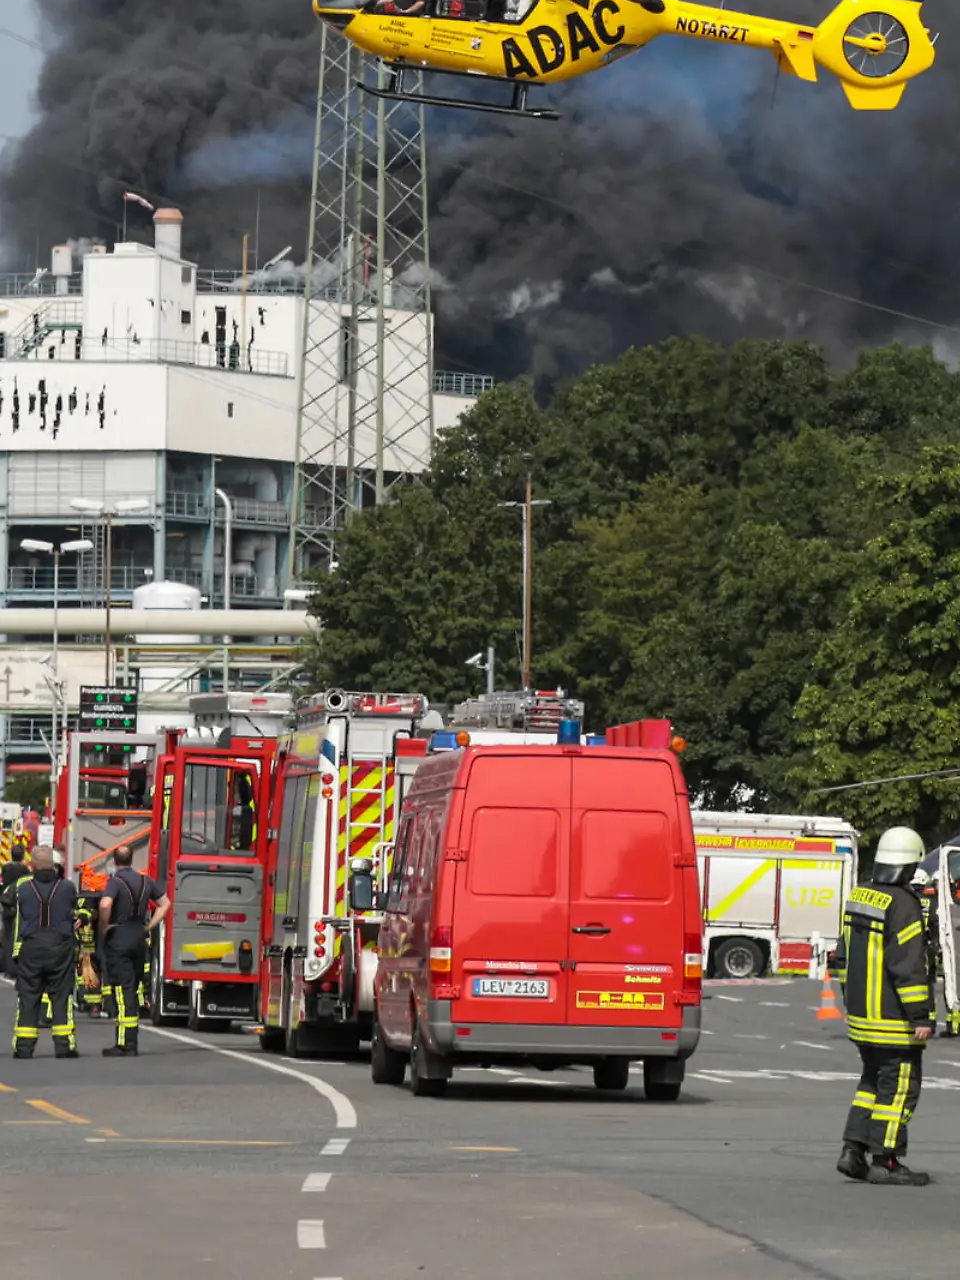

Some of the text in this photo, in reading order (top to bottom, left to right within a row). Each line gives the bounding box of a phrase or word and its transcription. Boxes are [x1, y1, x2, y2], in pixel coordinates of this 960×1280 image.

[675, 16, 750, 42] NOTARZT
[482, 980, 545, 994] LEV 2163
